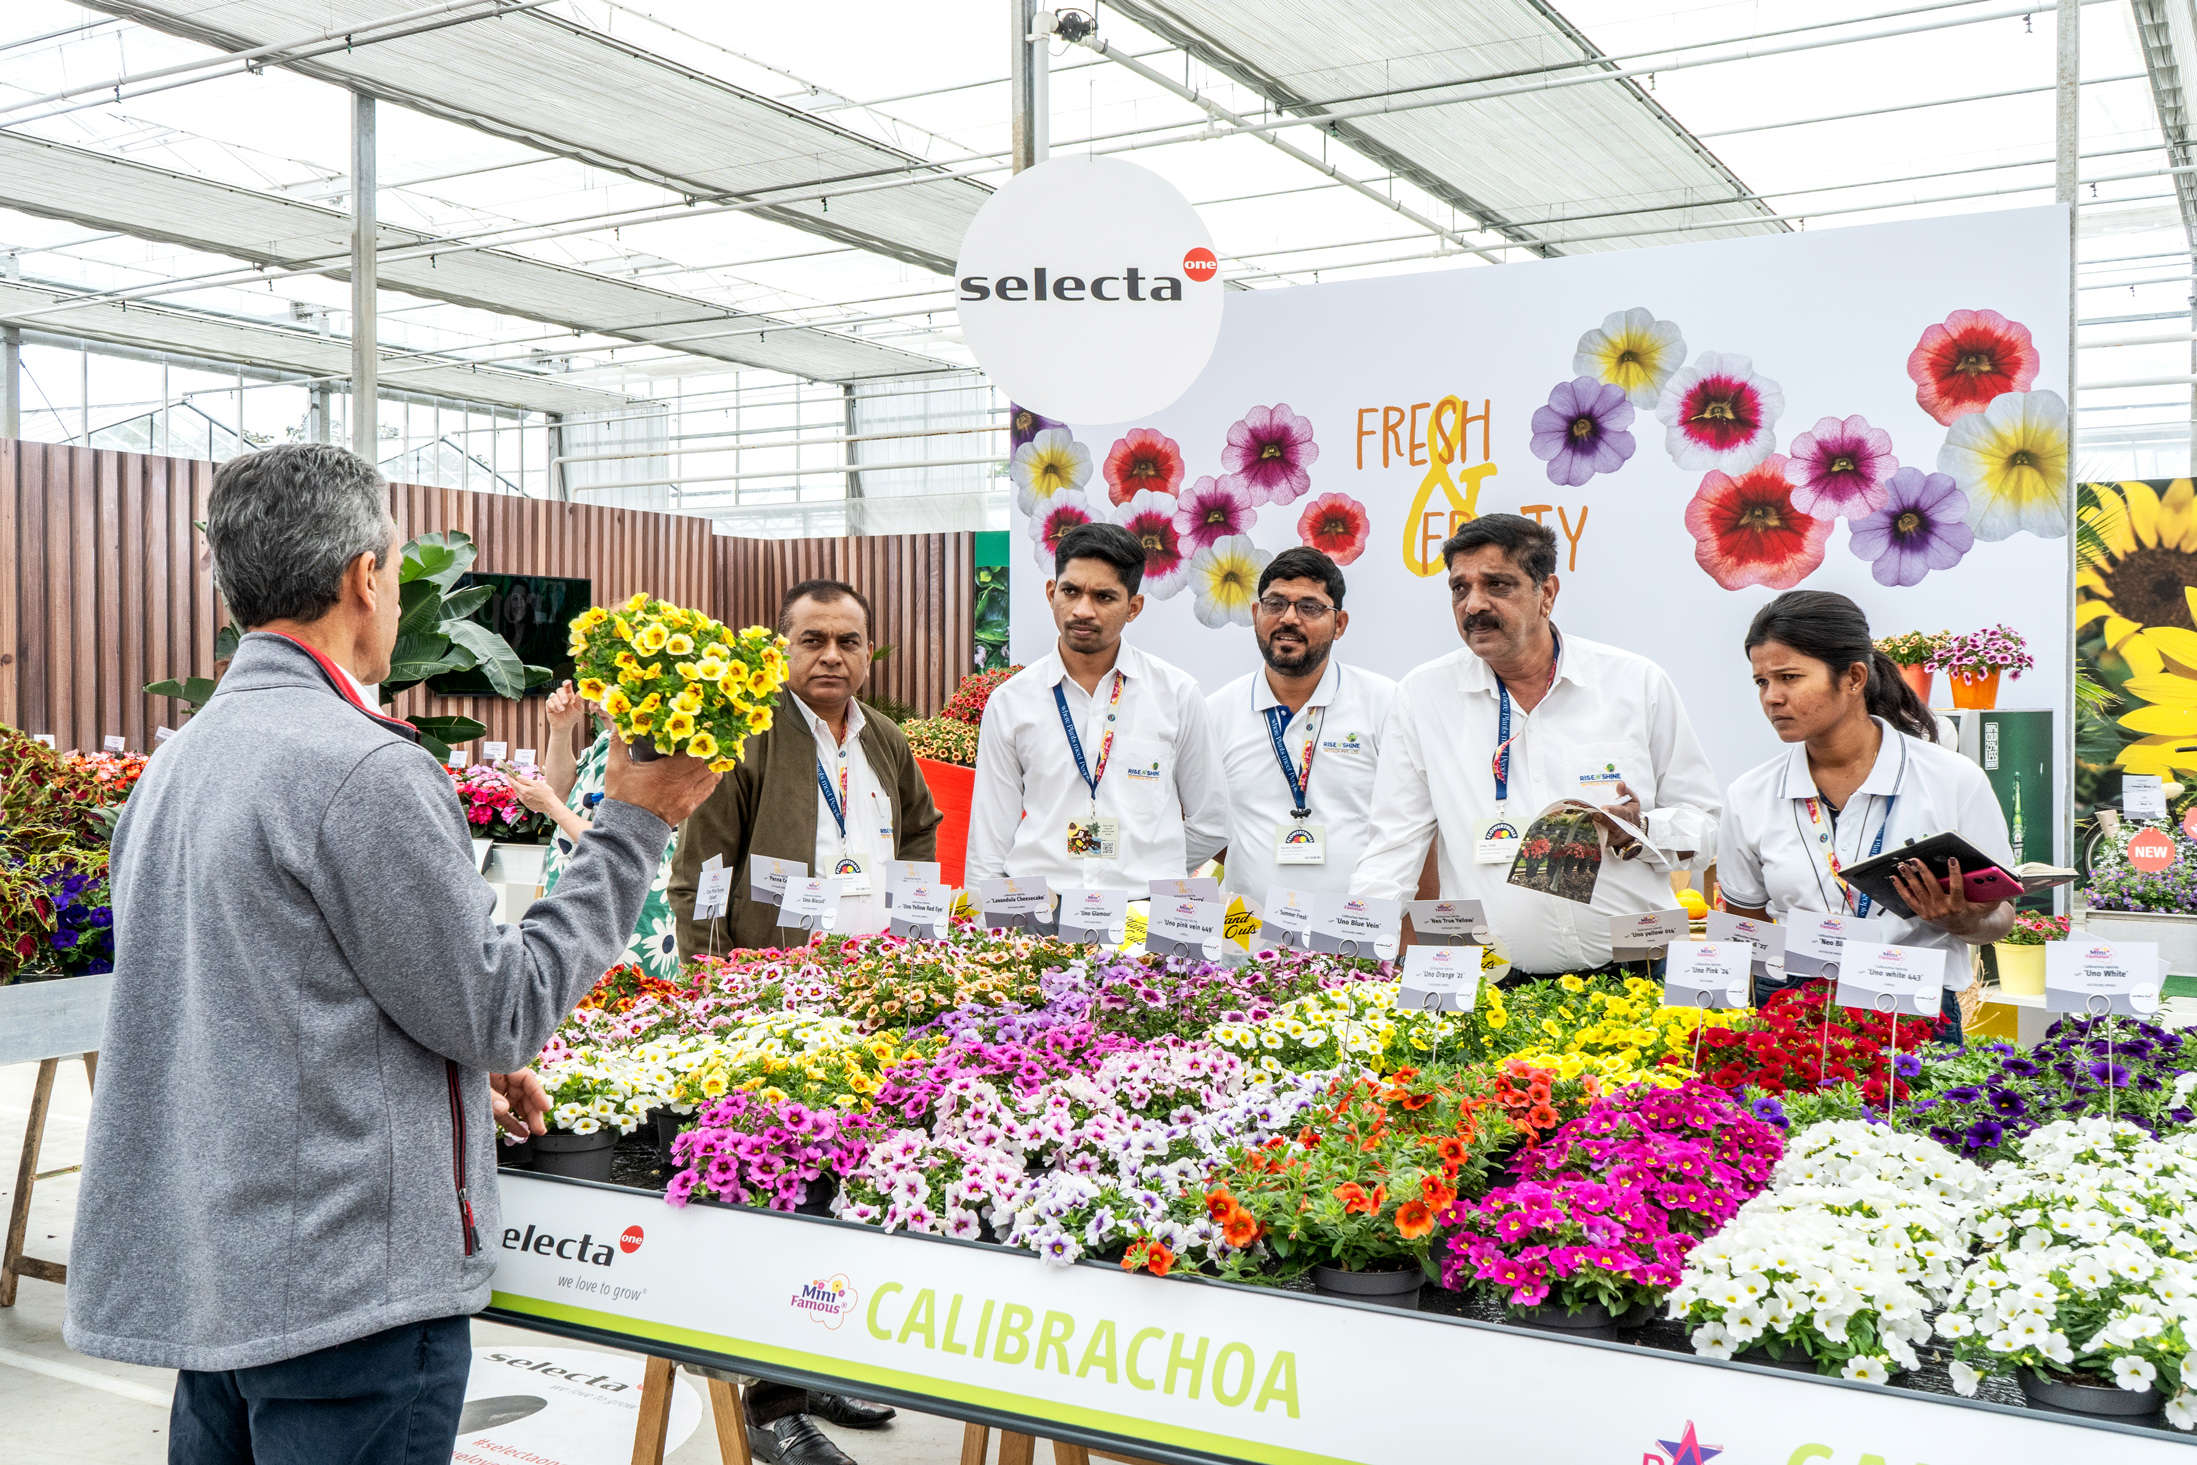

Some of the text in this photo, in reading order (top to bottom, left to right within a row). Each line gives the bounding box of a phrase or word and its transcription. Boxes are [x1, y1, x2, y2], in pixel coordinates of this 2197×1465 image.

[1184, 260, 1217, 270] one
[960, 267, 1182, 301] selecta
[1357, 399, 1490, 470] FRESH
[1403, 394, 1498, 578] &
[1422, 504, 1588, 574] FTY
[1067, 722, 1078, 744] Plants
[1275, 735, 1285, 756] Plants
[2135, 846, 2168, 858] NEW
[1177, 921, 1188, 929] pink
[1224, 910, 1254, 925] tand
[1351, 919, 1364, 927] Blue
[1225, 923, 1259, 939] Outs
[1436, 971, 1454, 979] Orange
[1886, 971, 1906, 979] white
[502, 1224, 615, 1267] electa
[621, 1233, 643, 1246] one
[557, 1275, 575, 1288] we
[575, 1276, 598, 1293] love
[601, 1281, 611, 1296] to
[801, 1284, 836, 1303] Mini
[866, 1281, 1301, 1419] CALIBRACHOA
[483, 1353, 629, 1392] selecta
